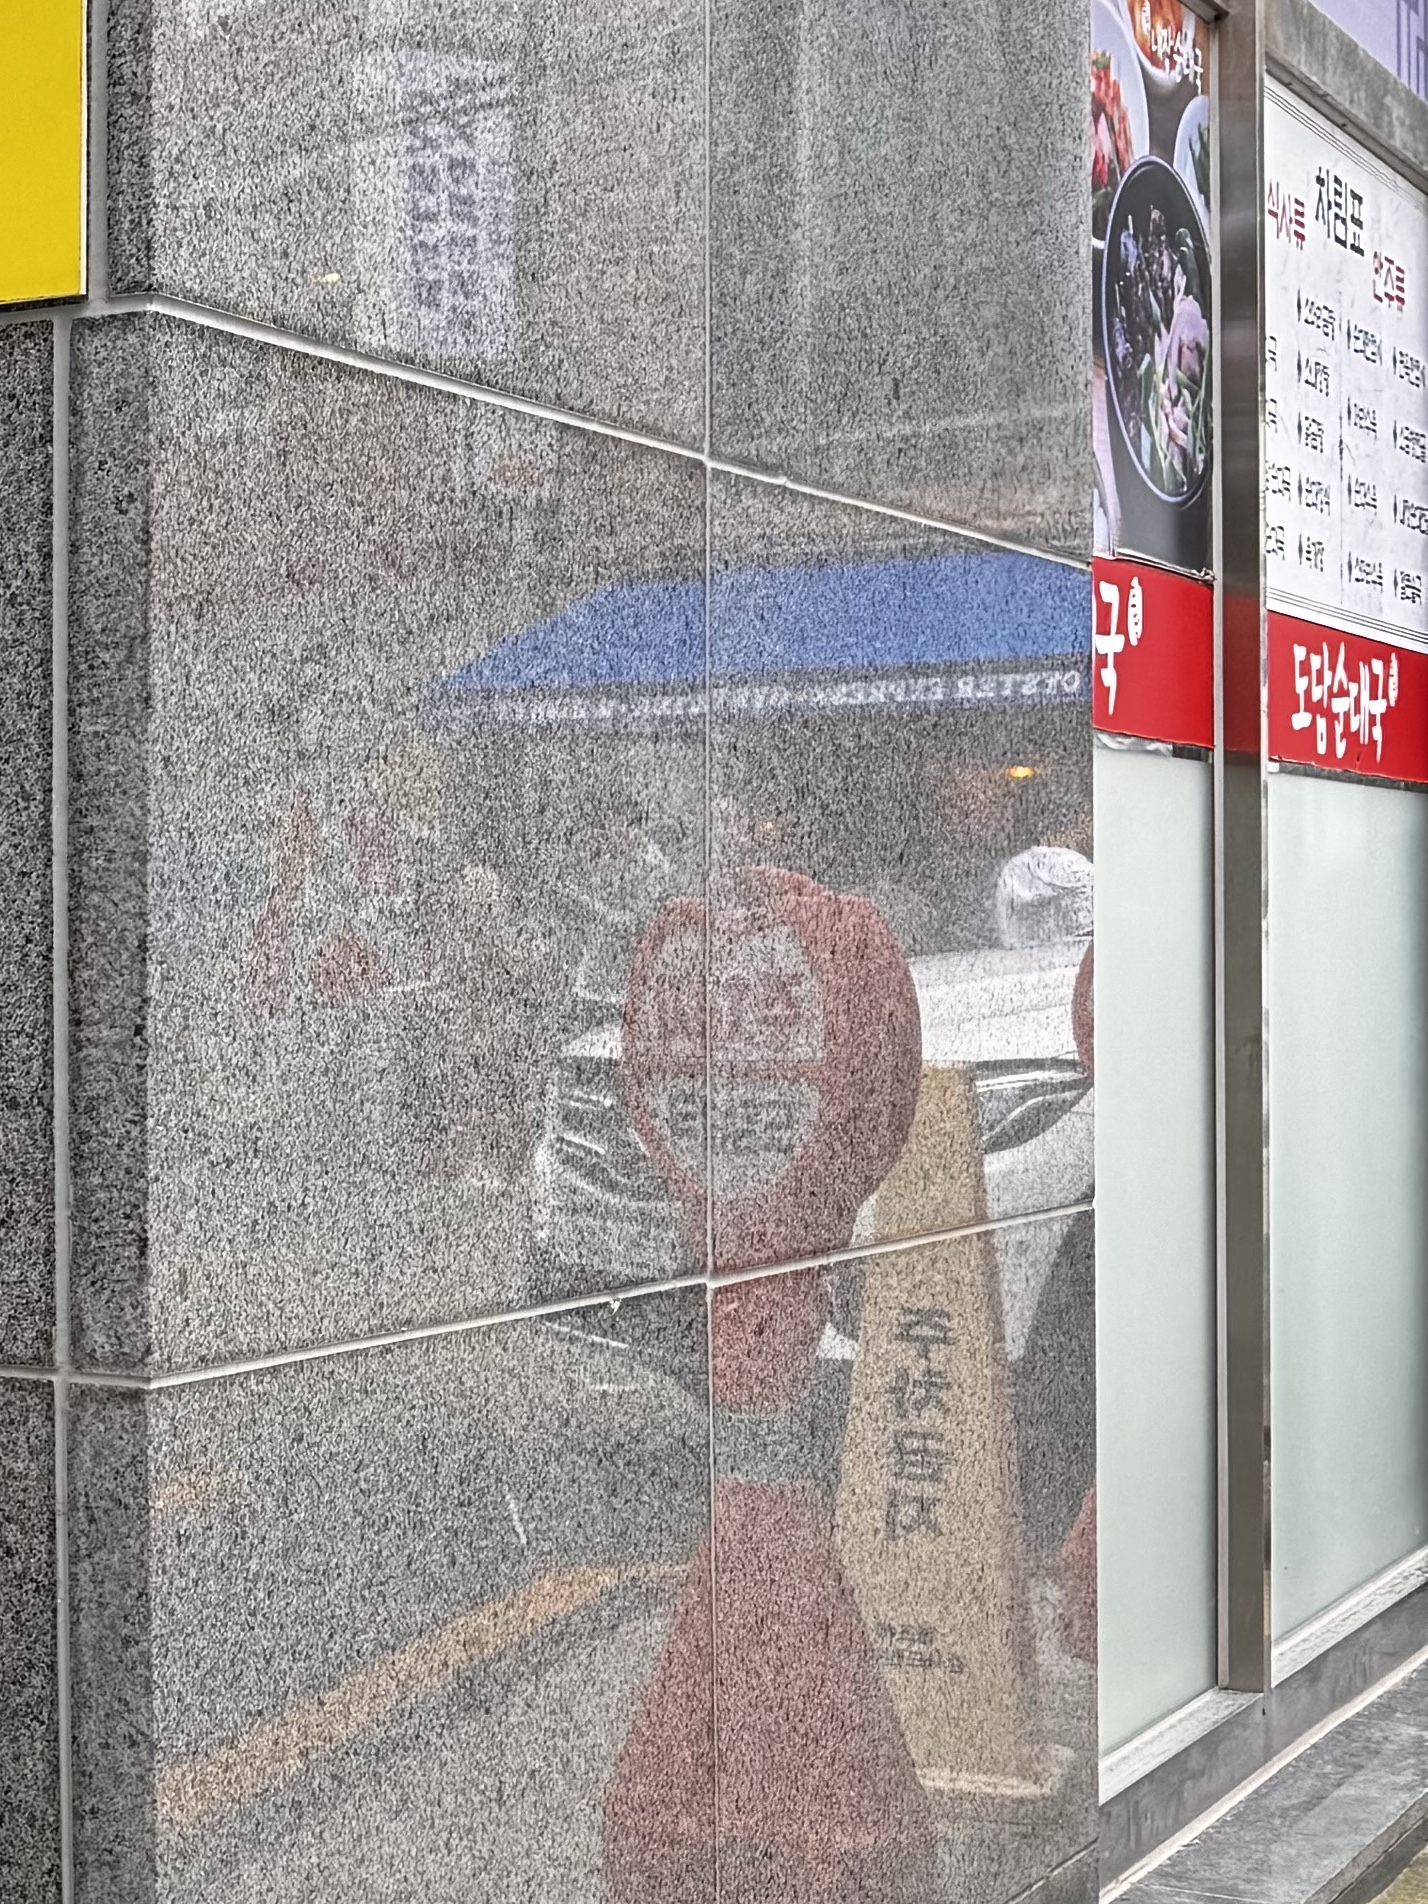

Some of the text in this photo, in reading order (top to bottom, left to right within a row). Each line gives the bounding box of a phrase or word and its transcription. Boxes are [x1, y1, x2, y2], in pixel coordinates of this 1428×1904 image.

[1267, 178, 1307, 251] 식사류
[1315, 166, 1365, 258] 차림표
[1372, 250, 1406, 313] 안주류
[1290, 641, 1388, 764] 도담순대국
